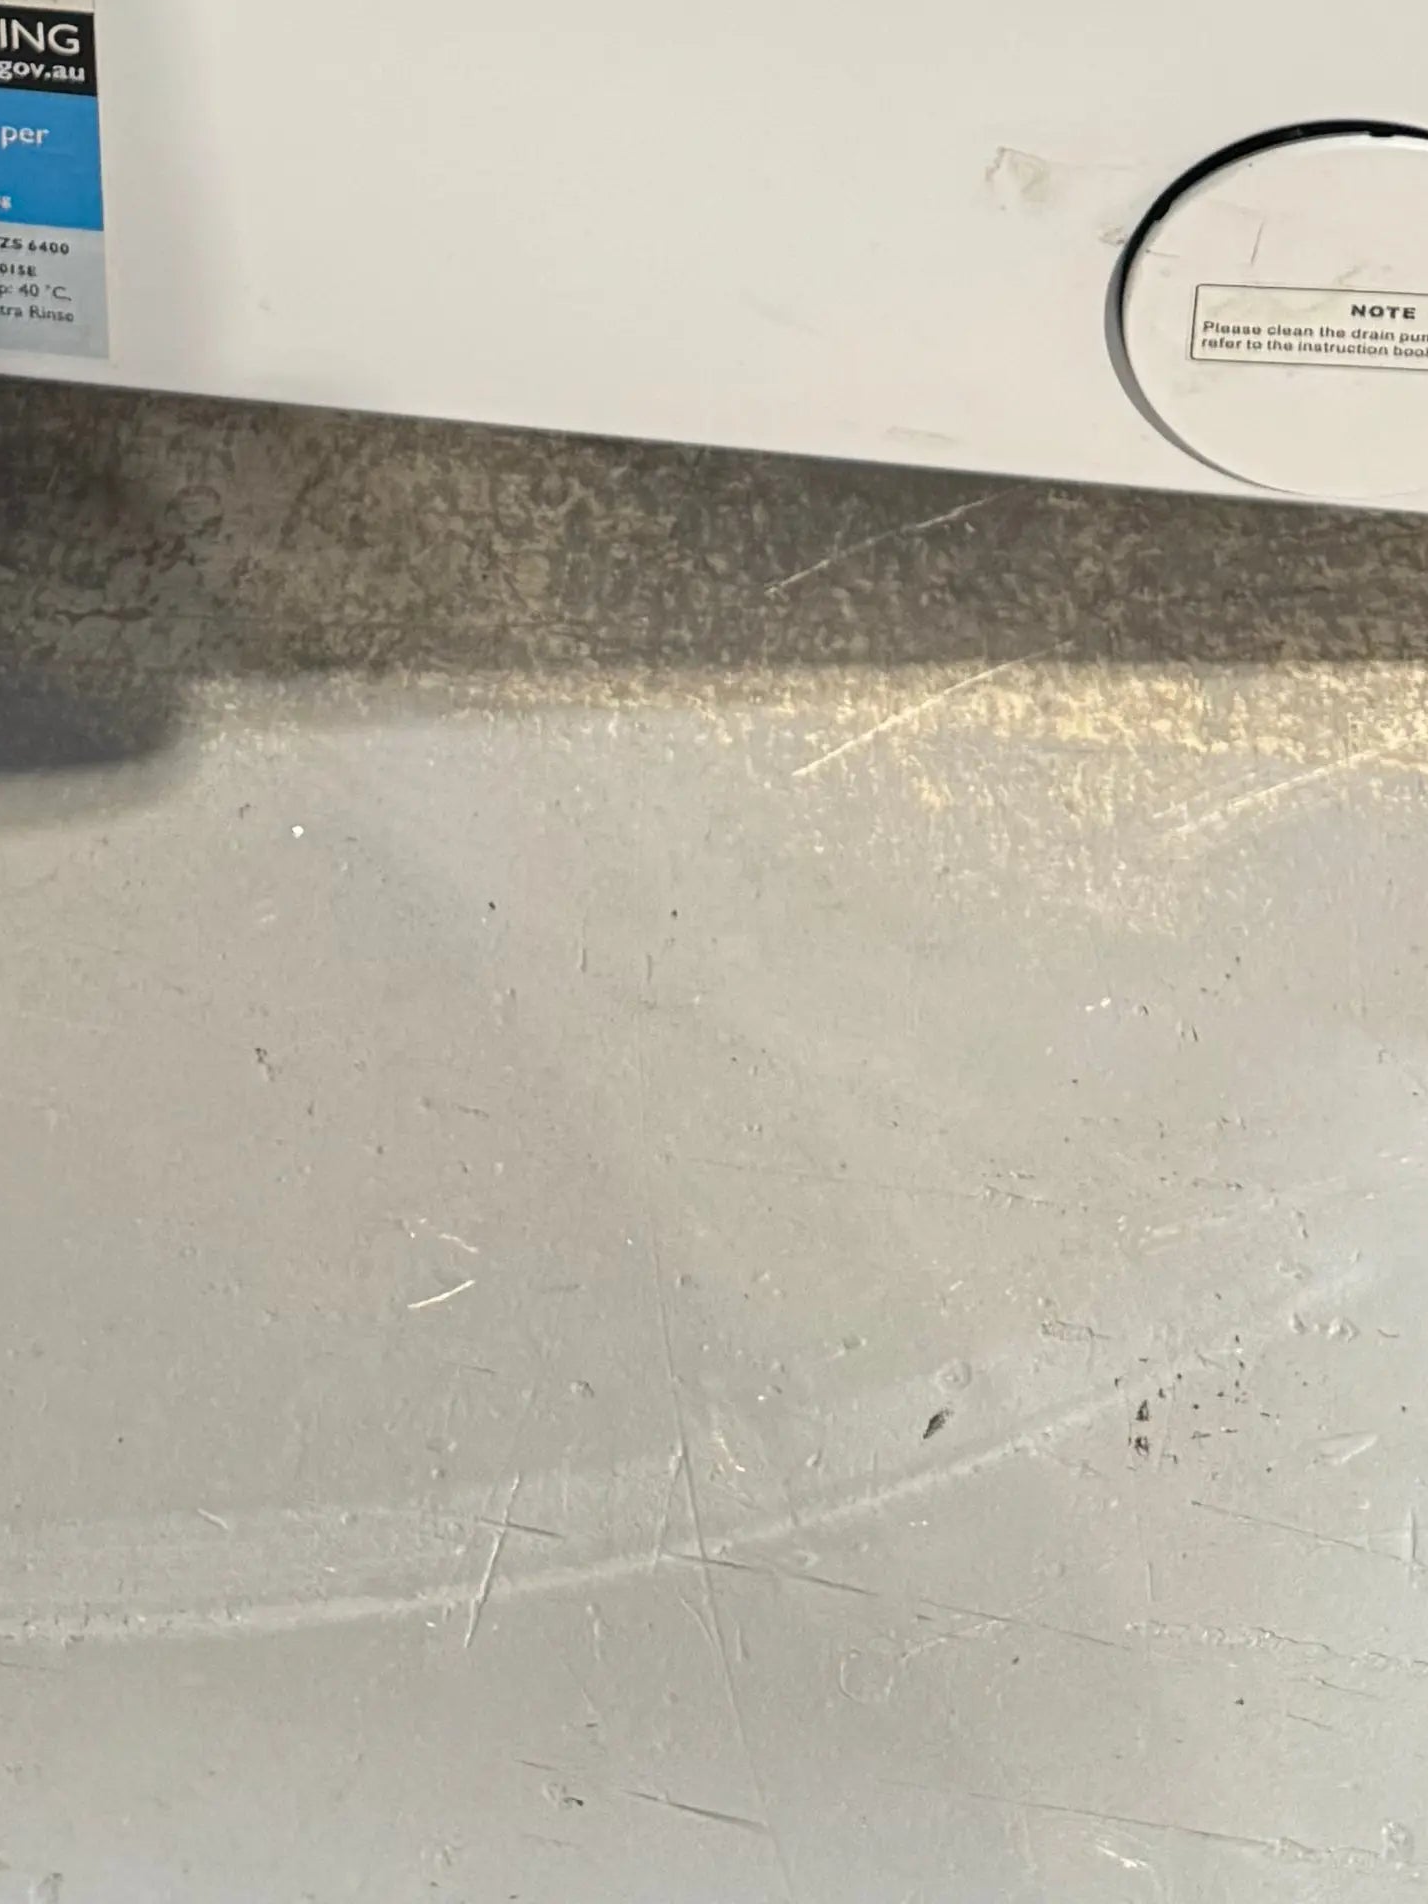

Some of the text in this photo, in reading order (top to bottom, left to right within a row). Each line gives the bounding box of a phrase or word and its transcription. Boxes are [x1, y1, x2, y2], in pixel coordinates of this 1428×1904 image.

[0, 123, 49, 148] per
[28, 240, 70, 255] 6400
[18, 283, 39, 298] 40
[29, 305, 74, 323] Rinse
[1351, 303, 1416, 320] NOTE
[1203, 321, 1262, 335] Please
[1267, 325, 1314, 337] clean
[1320, 327, 1345, 338] the
[1351, 328, 1394, 342] drain
[1202, 336, 1242, 350] refer
[1247, 339, 1262, 351] to
[1267, 340, 1293, 352] the
[1299, 341, 1388, 357] instruction
